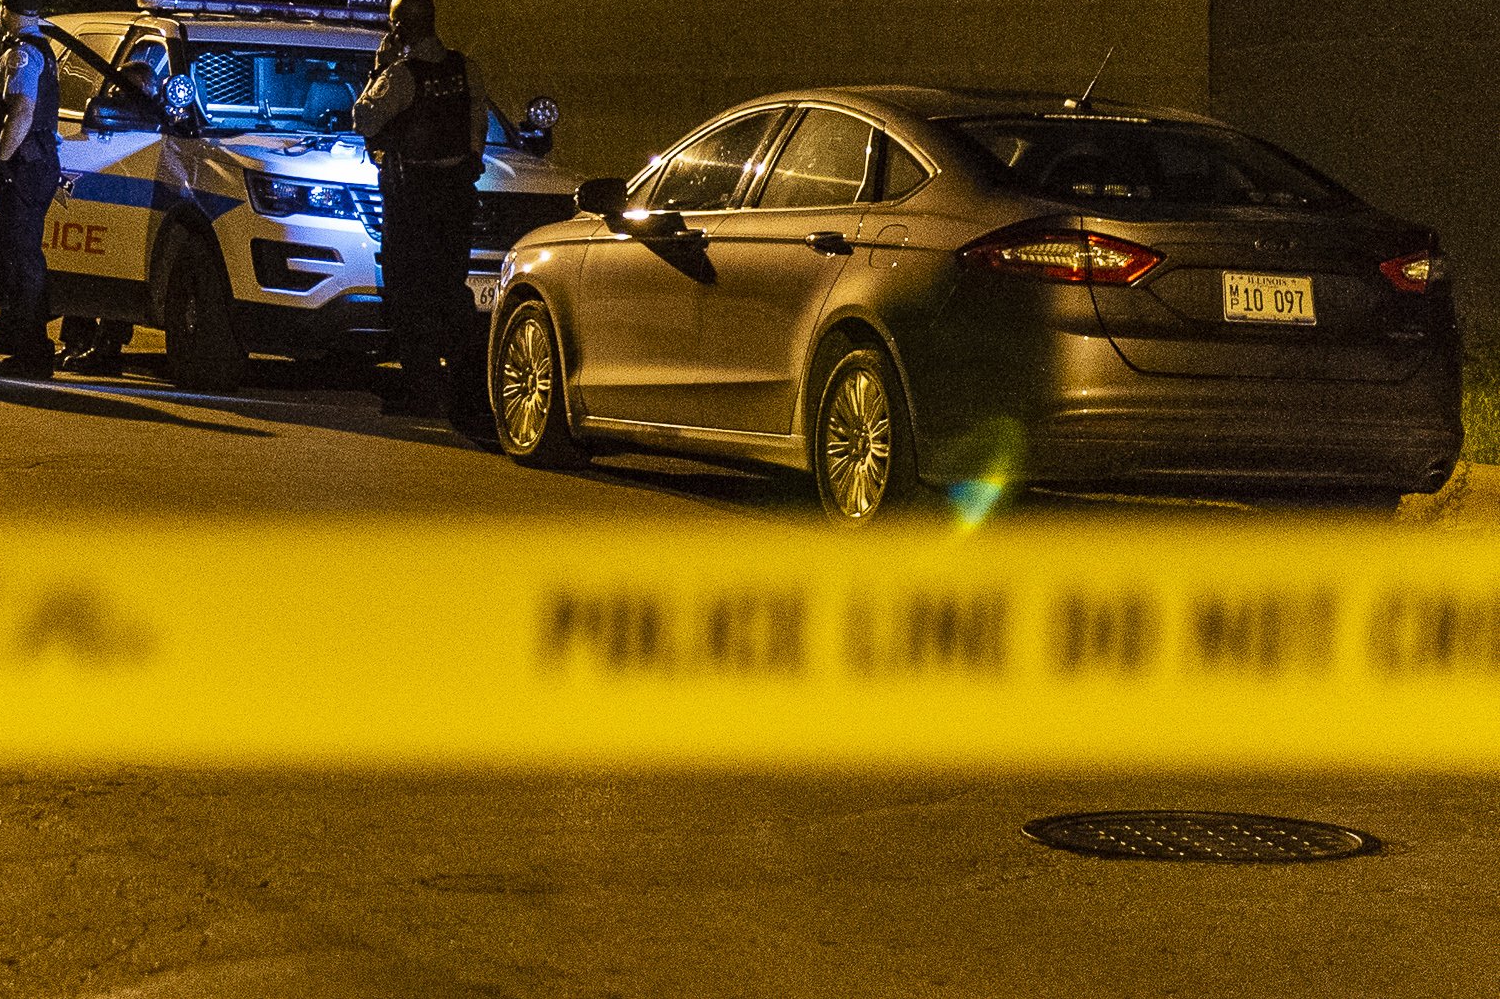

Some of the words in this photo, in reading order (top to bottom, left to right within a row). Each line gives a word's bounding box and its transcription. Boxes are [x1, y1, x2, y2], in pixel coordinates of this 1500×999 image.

[41, 221, 108, 255] ICE
[1243, 287, 1264, 312] 10
[1273, 289, 1304, 315] 097
